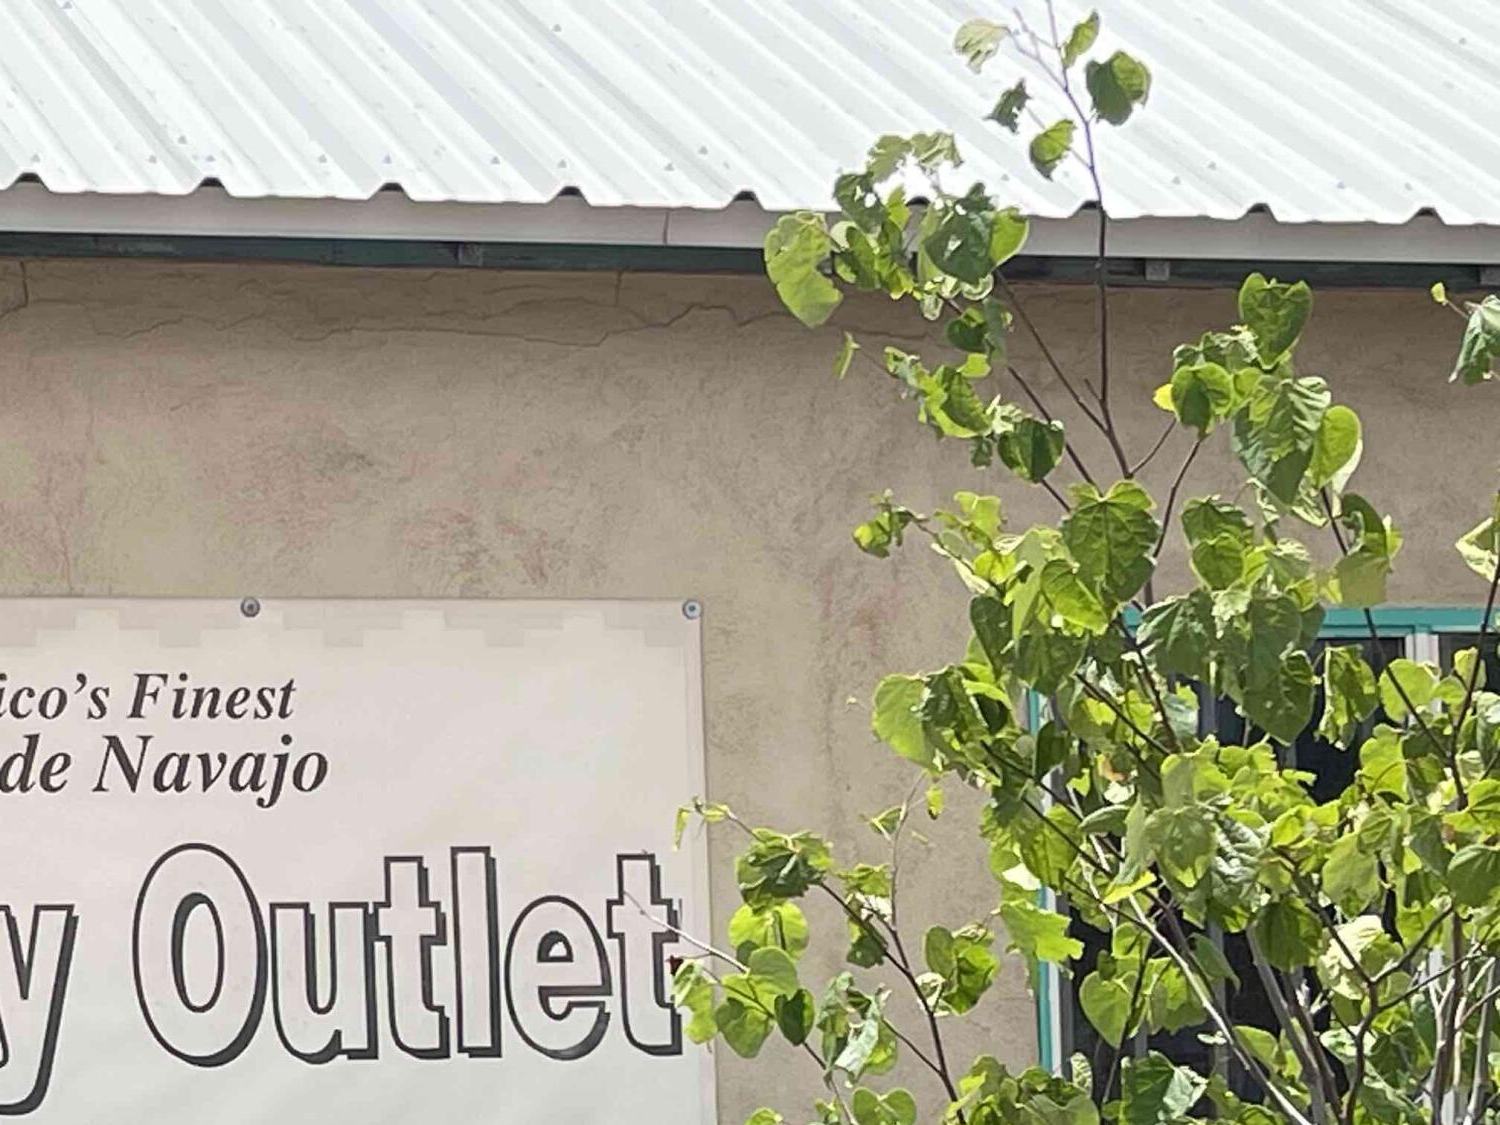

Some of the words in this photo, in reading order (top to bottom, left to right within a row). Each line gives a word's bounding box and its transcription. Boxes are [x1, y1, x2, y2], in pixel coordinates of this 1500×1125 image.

[126, 672, 297, 720] Finest
[93, 733, 329, 809] Navajo
[132, 841, 683, 1069] Outlet
